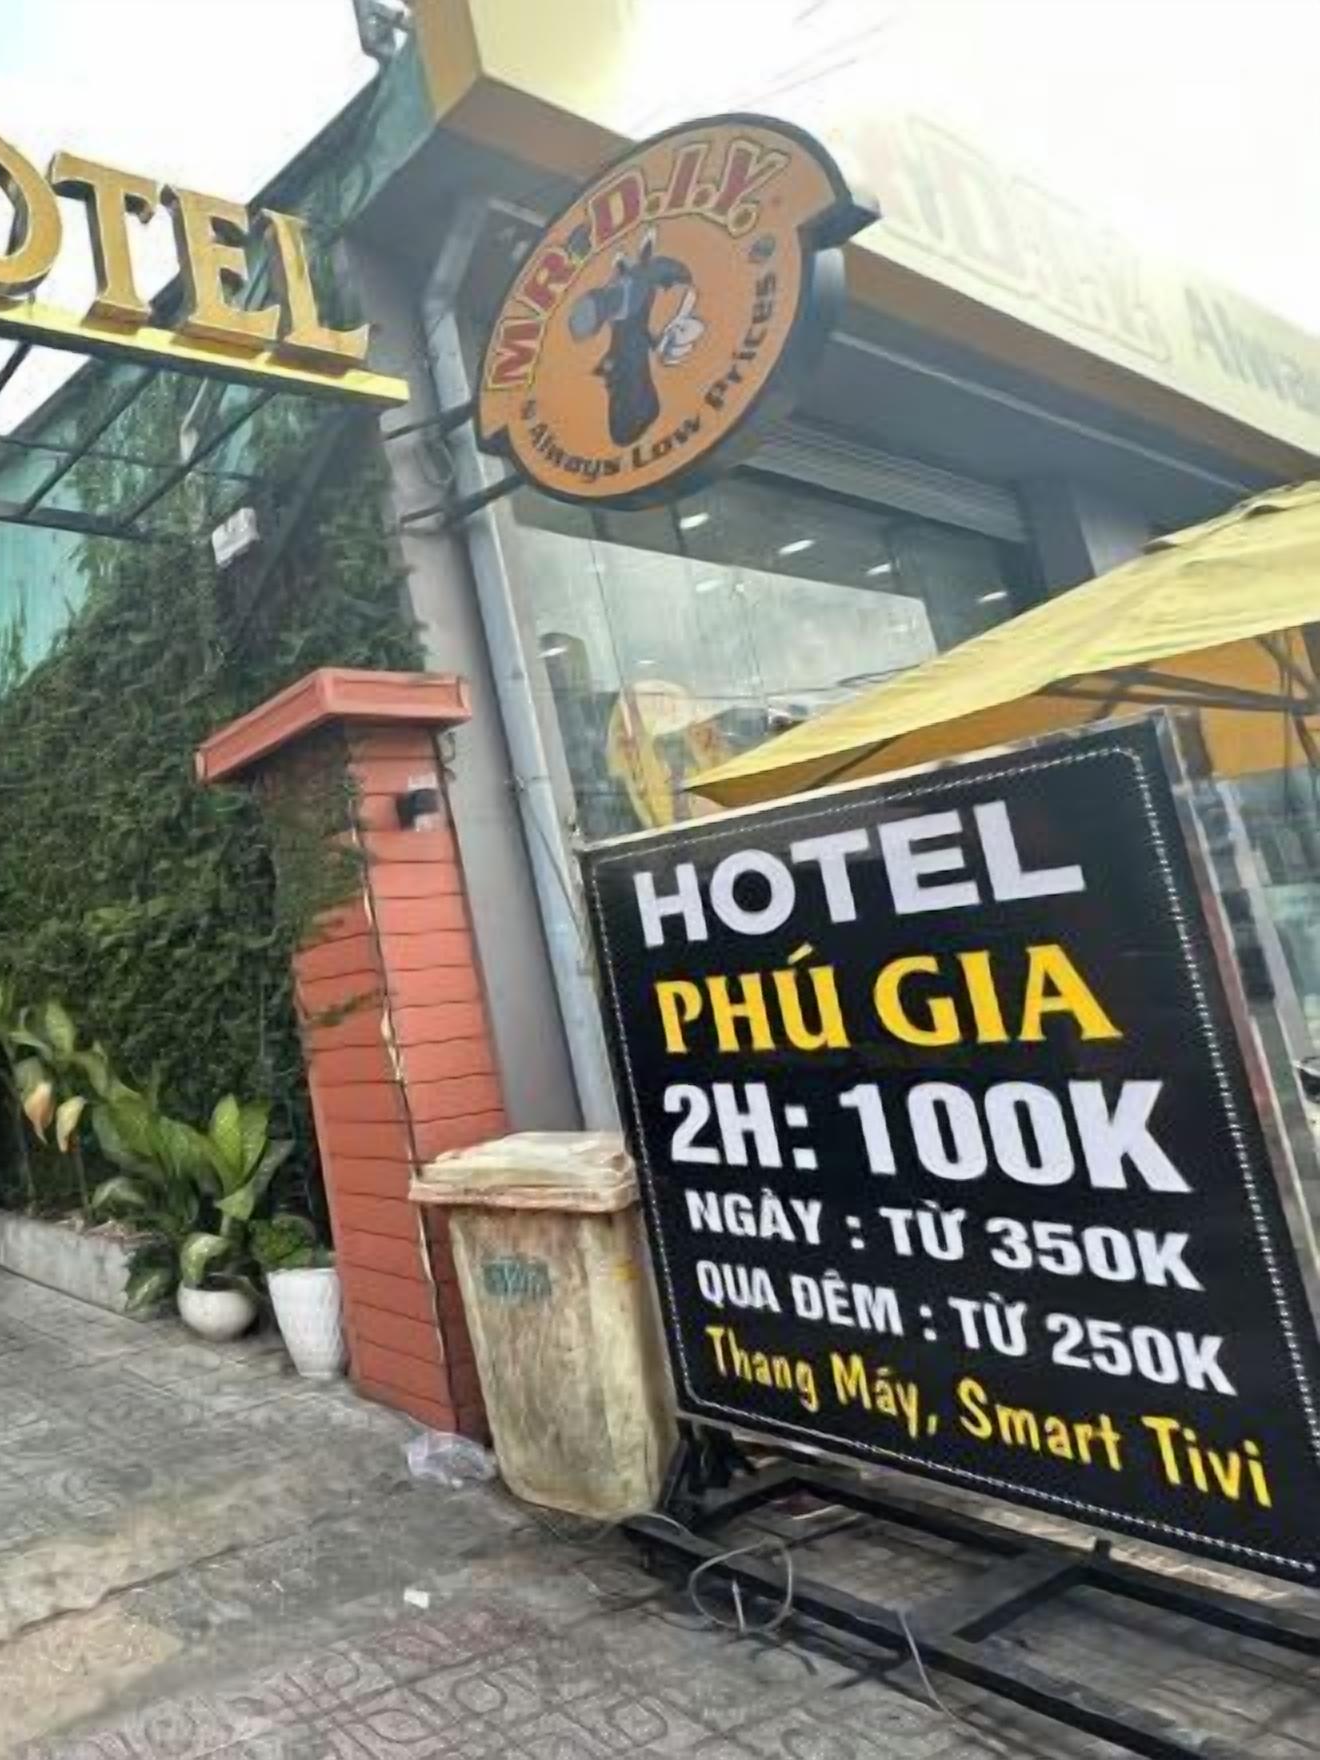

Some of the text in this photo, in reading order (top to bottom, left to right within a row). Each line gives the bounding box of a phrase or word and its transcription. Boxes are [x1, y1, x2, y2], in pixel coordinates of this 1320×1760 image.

[530, 272, 776, 483] Always Low Prices
[633, 801, 1086, 949] HOTEL
[654, 943, 1124, 1054] PHÚ GIA
[663, 1080, 1194, 1194] 2H: 100K
[685, 1187, 822, 1245] NGÀY
[878, 1199, 966, 1261] TỪ
[985, 1217, 1205, 1292] 350K
[696, 1260, 781, 1313] QUA
[948, 1292, 1028, 1357] TỪ
[1045, 1312, 1238, 1397] 250K
[705, 1326, 819, 1412] Thang
[956, 1378, 1122, 1470] Smart
[1141, 1415, 1272, 1507] Tivi
